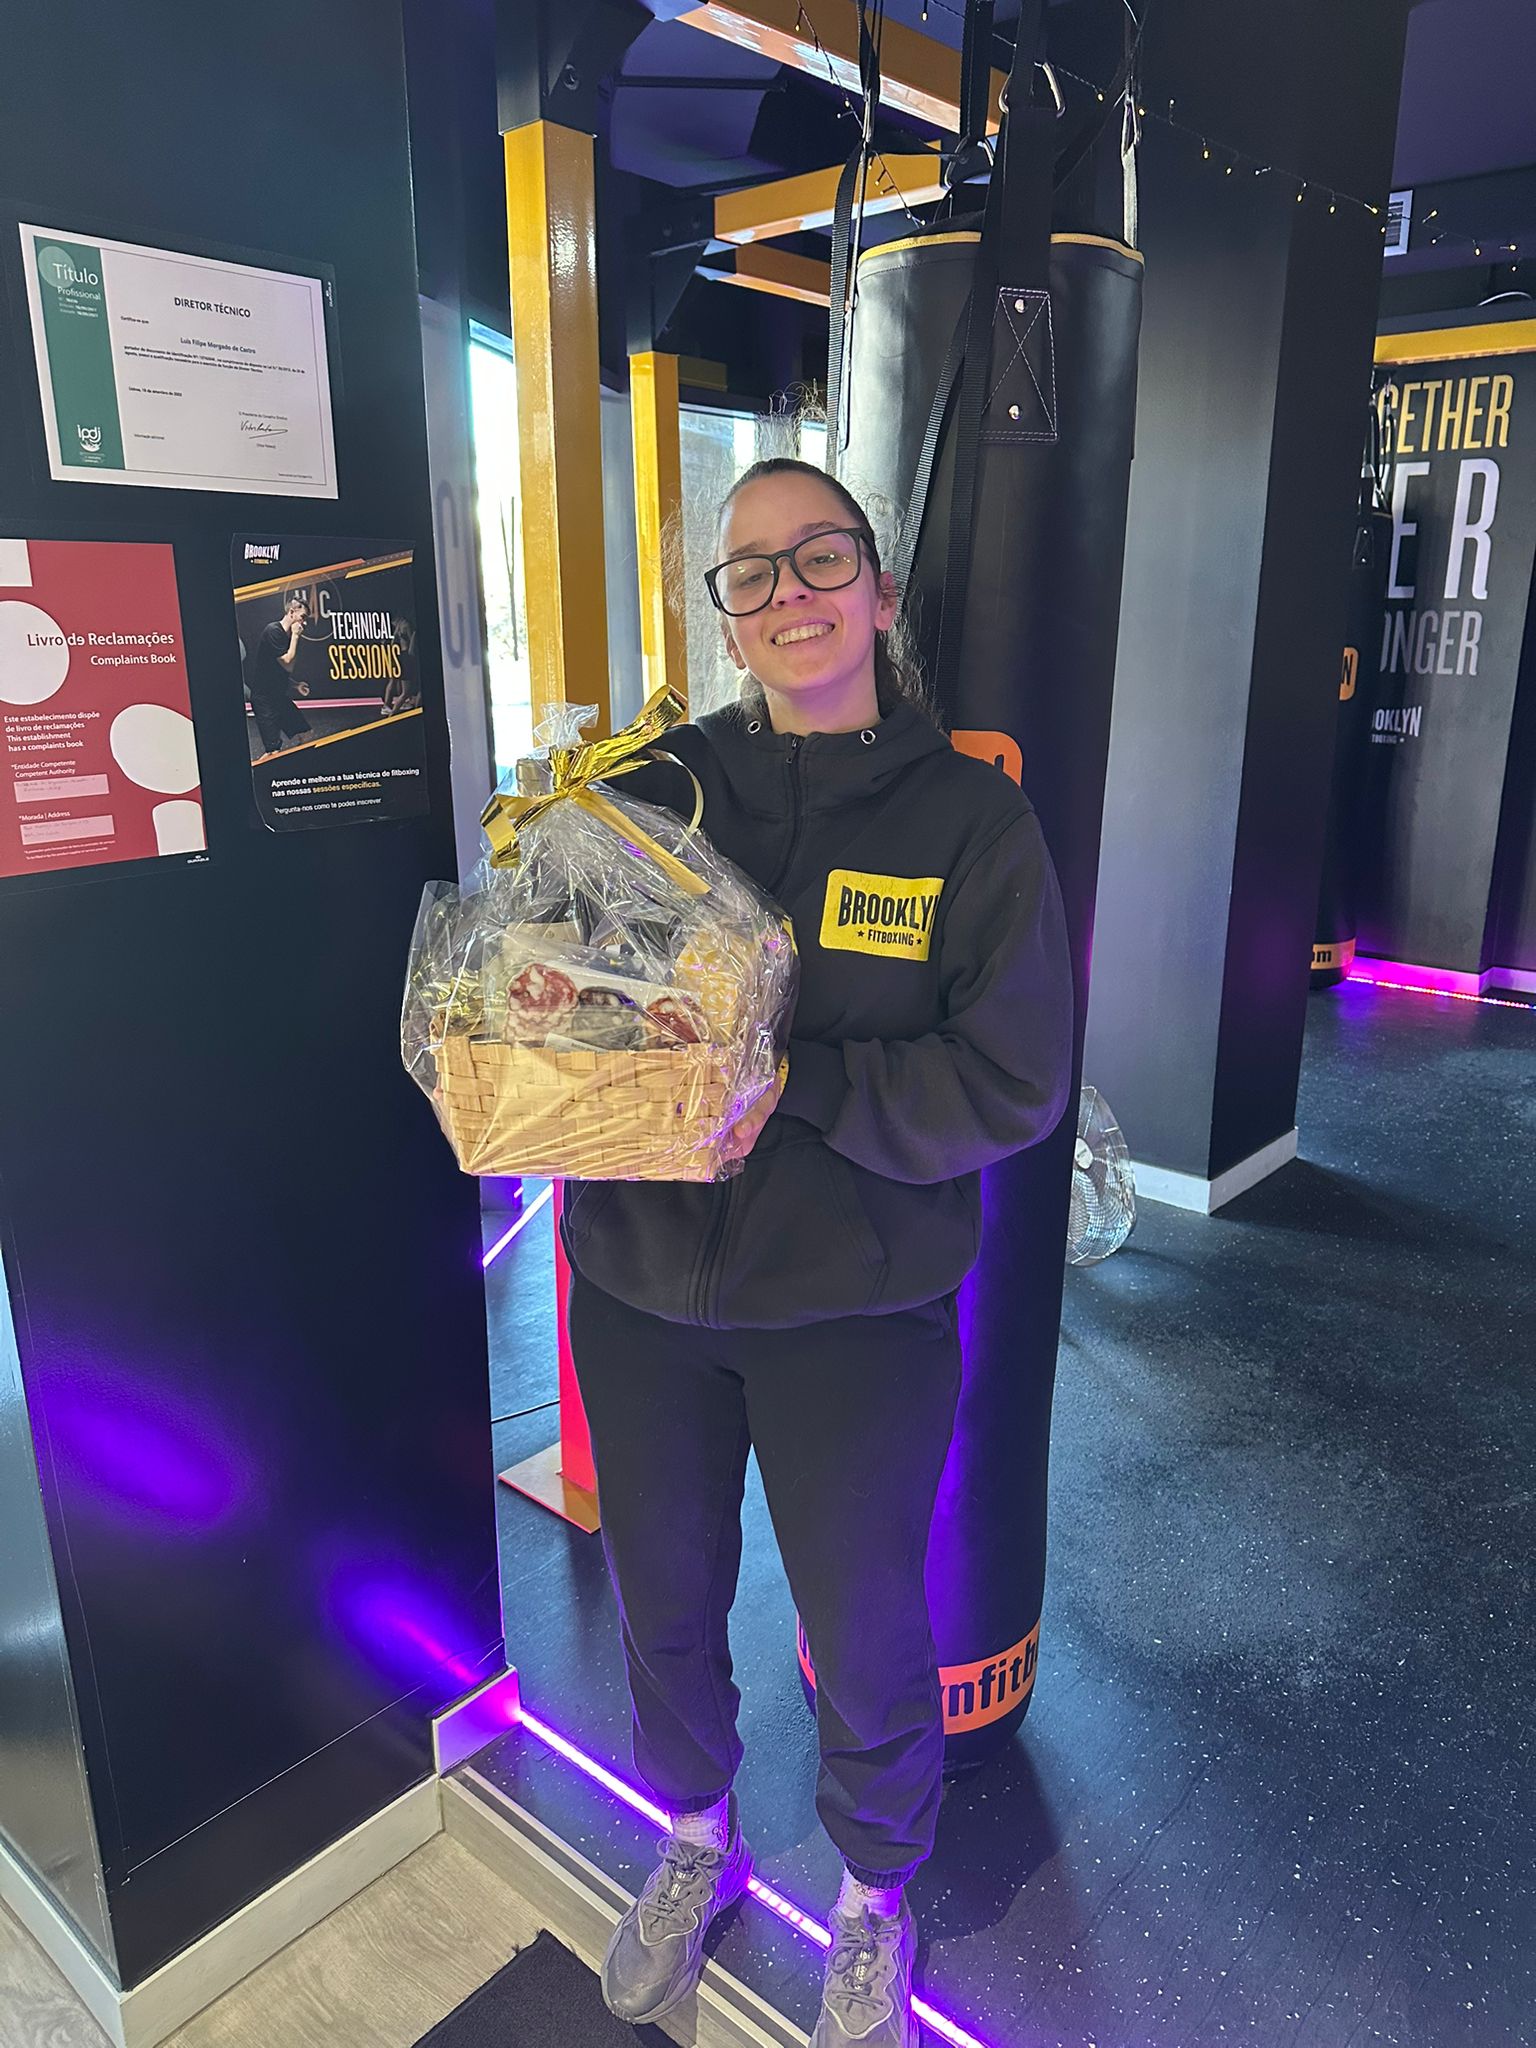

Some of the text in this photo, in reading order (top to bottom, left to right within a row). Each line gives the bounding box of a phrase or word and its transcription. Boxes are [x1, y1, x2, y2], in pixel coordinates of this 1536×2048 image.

[53, 263, 98, 285] Título
[57, 286, 101, 300] Profissional
[174, 297, 251, 318] DIRETOR TÉCNICO
[1444, 457, 1500, 600] R
[244, 543, 280, 560] BROOKLYN
[330, 612, 394, 640] TECHNICAL
[27, 632, 174, 648] Livro de Reclamações
[91, 653, 176, 667] Complaints Book
[328, 644, 401, 681] SESSIONS
[4, 711, 100, 723] Este estabelecimento dispõe
[1371, 705, 1422, 737] OKLYN
[16, 723, 32, 732] livro
[33, 723, 42, 731] de
[43, 722, 85, 731] reclamações
[23, 732, 71, 742] establishment
[8, 744, 21, 752] has
[28, 742, 65, 751] complaints
[66, 740, 84, 748] book
[41, 760, 76, 769] Competente
[15, 767, 76, 779] Competent Authority
[271, 779, 301, 788] Aprende
[308, 776, 336, 784] melhora
[355, 771, 381, 779] técnica
[381, 770, 390, 778] de
[391, 768, 420, 777] fitboxing
[286, 788, 312, 796] nossas
[312, 785, 340, 794] sessões
[338, 800, 356, 809] podes
[357, 797, 382, 806] inscrever
[868, 929, 914, 946] FITBOXING
[1313, 951, 1332, 963] m
[941, 1639, 1038, 1718] nfitb
